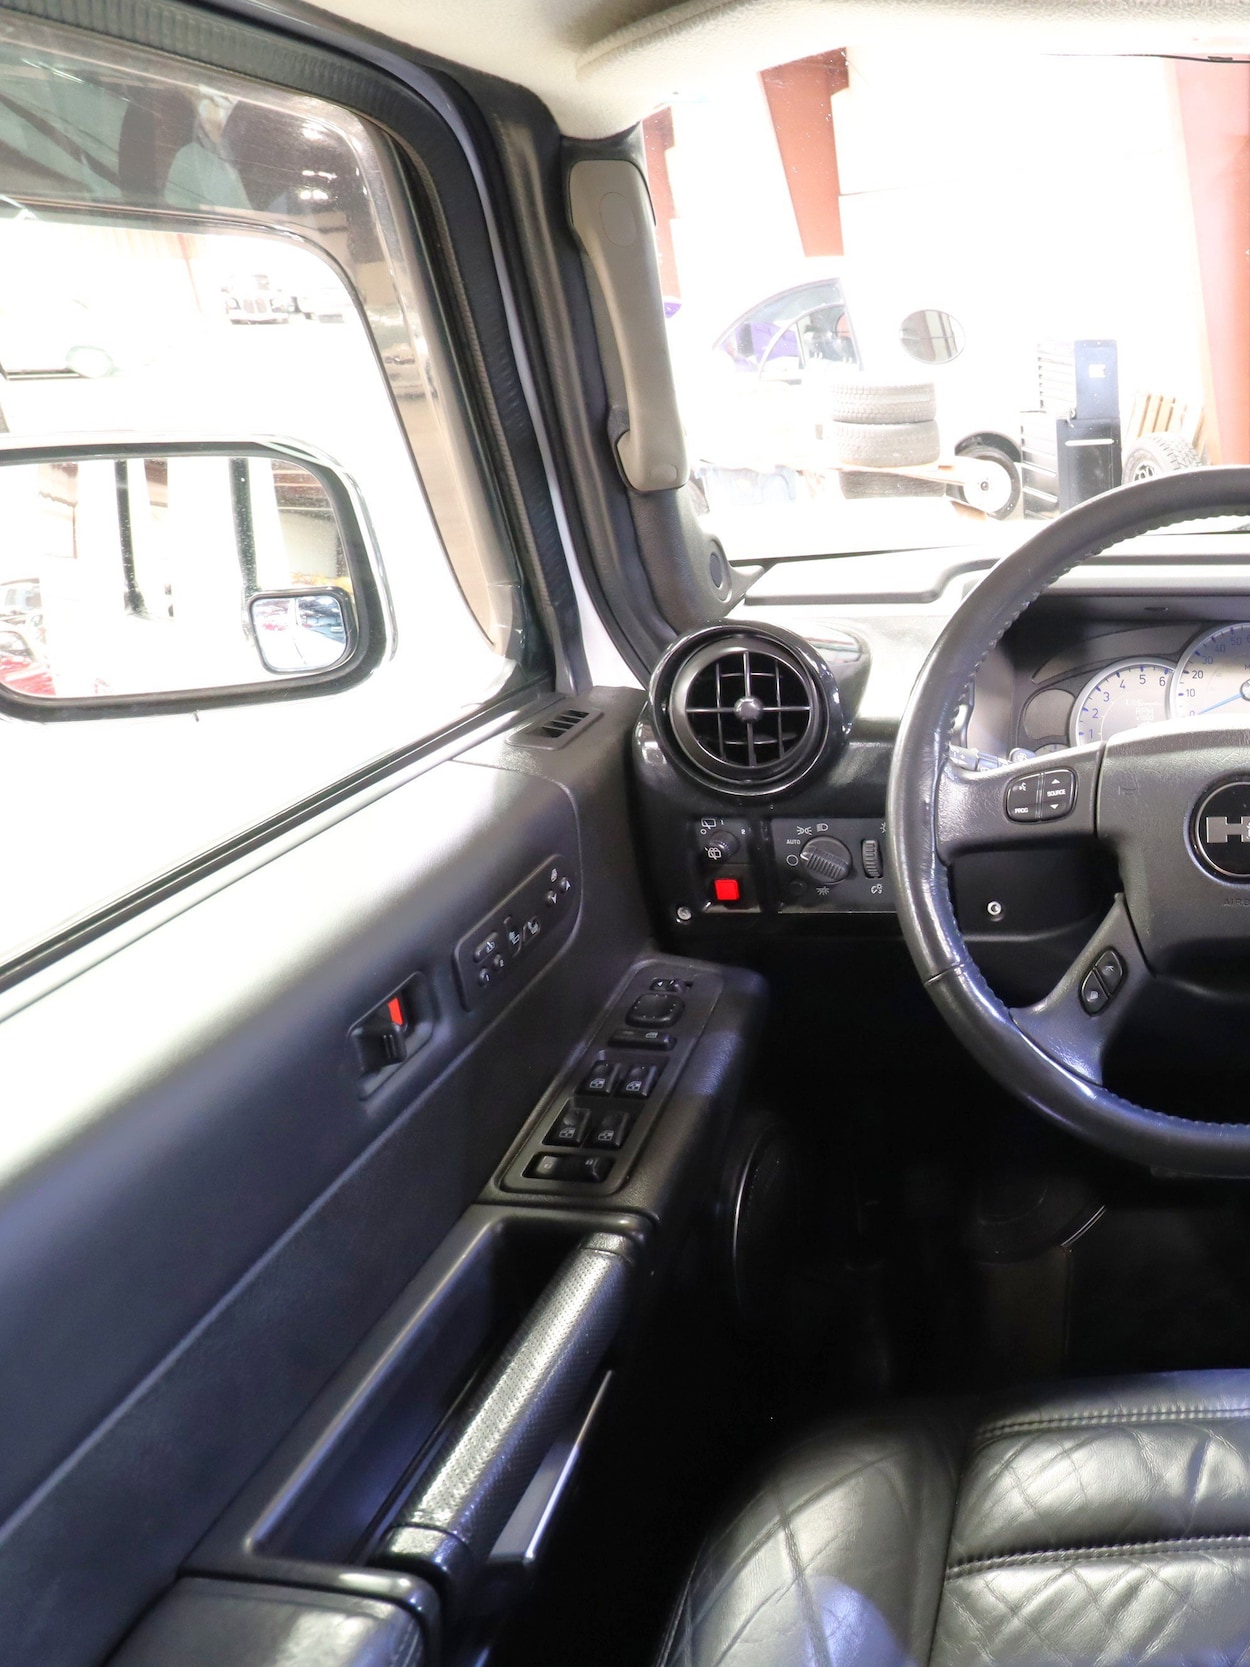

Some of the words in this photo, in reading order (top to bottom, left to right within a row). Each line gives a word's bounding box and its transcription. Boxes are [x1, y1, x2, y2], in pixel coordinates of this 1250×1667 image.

[1230, 637, 1242, 646] 50
[1215, 644, 1226, 653] 40
[1202, 655, 1214, 664] 30
[1139, 674, 1146, 685] 5
[1192, 670, 1204, 679] 20
[1119, 679, 1126, 689] 4
[1159, 676, 1166, 687] 6
[1103, 691, 1110, 702] 3
[1186, 688, 1196, 698] 10
[1091, 708, 1099, 719] 2
[1088, 728, 1094, 739] 1
[1047, 788, 1066, 797] SOURCE
